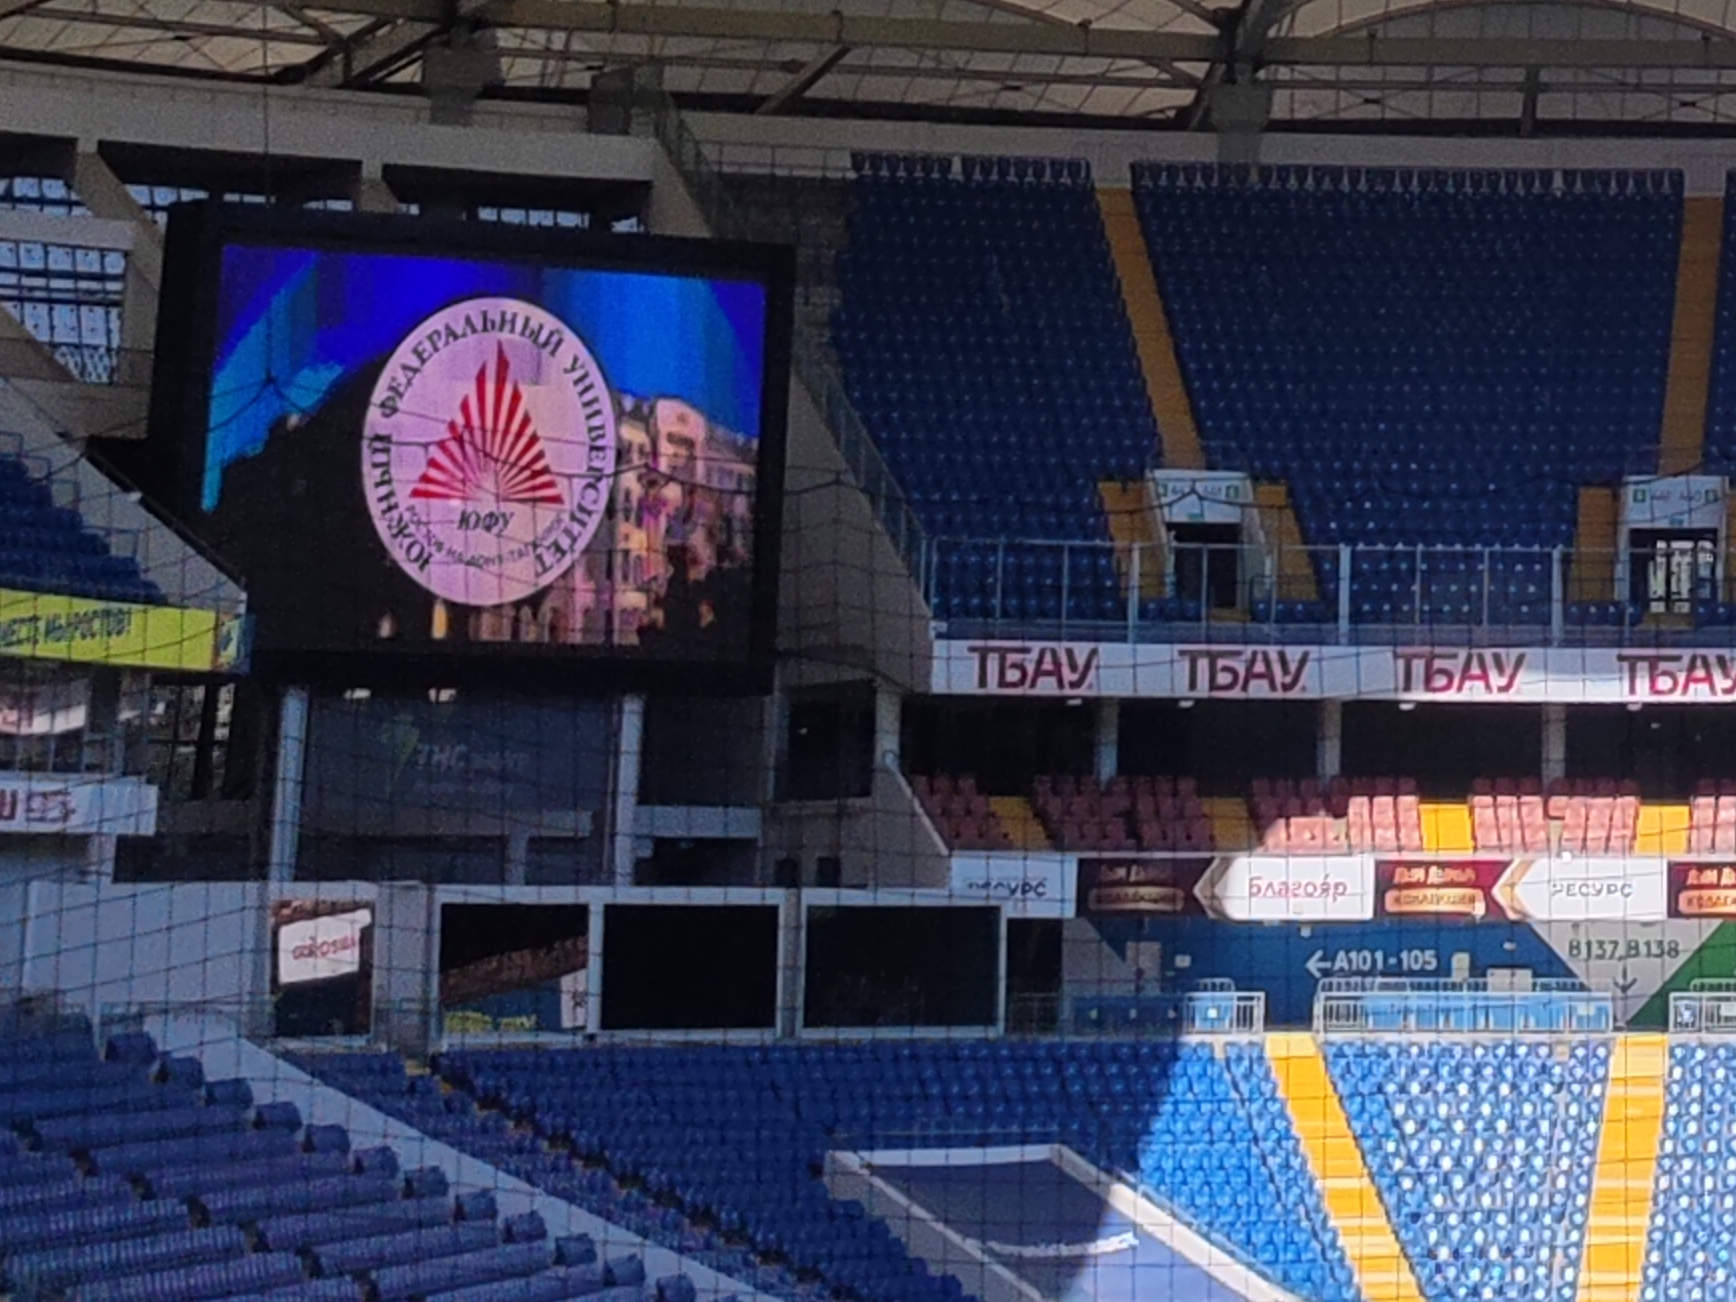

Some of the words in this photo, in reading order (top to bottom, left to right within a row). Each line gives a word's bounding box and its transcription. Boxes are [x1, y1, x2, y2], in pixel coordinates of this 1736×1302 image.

[378, 309, 565, 419] ФЕДЕРАЛЬНЫЙ
[369, 433, 436, 574] ЮЖНЫЙ
[456, 509, 515, 533] ЮФУ
[534, 353, 607, 577] УНИВЕРСИТЕТ
